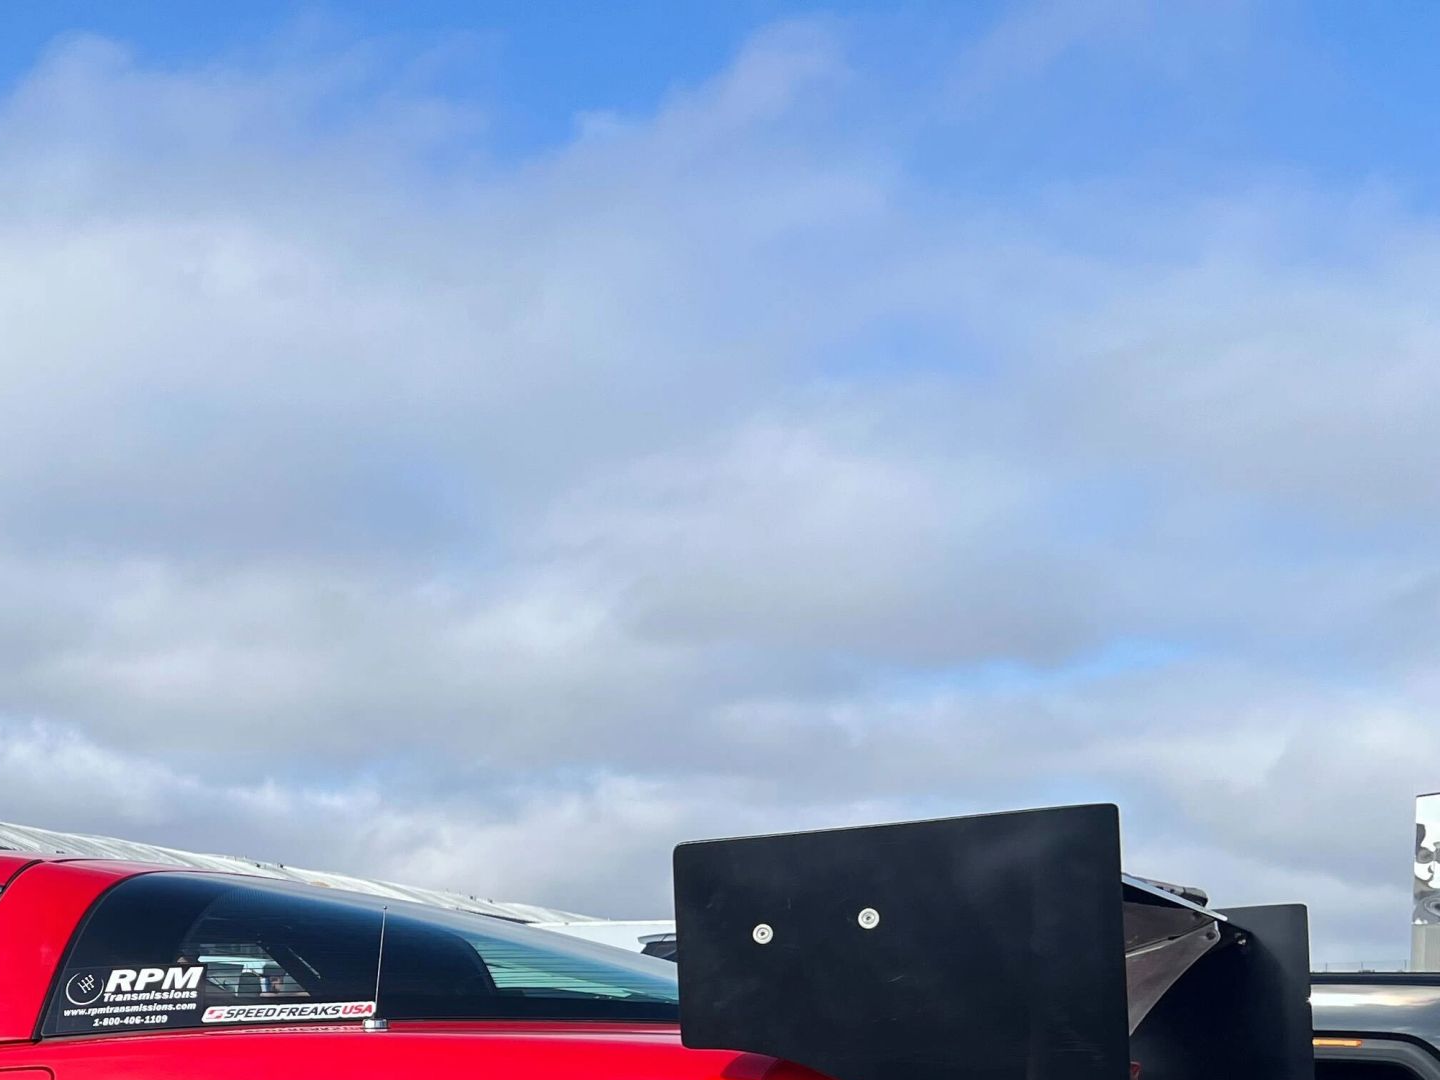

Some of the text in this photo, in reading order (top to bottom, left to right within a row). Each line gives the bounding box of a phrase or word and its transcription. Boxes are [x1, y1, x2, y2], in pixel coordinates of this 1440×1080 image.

[104, 966, 204, 993] RPM
[103, 989, 198, 1003] Transmissions
[63, 1002, 197, 1017] www.rpmtransmissions.com
[92, 1014, 168, 1027] 1-800-406-1109
